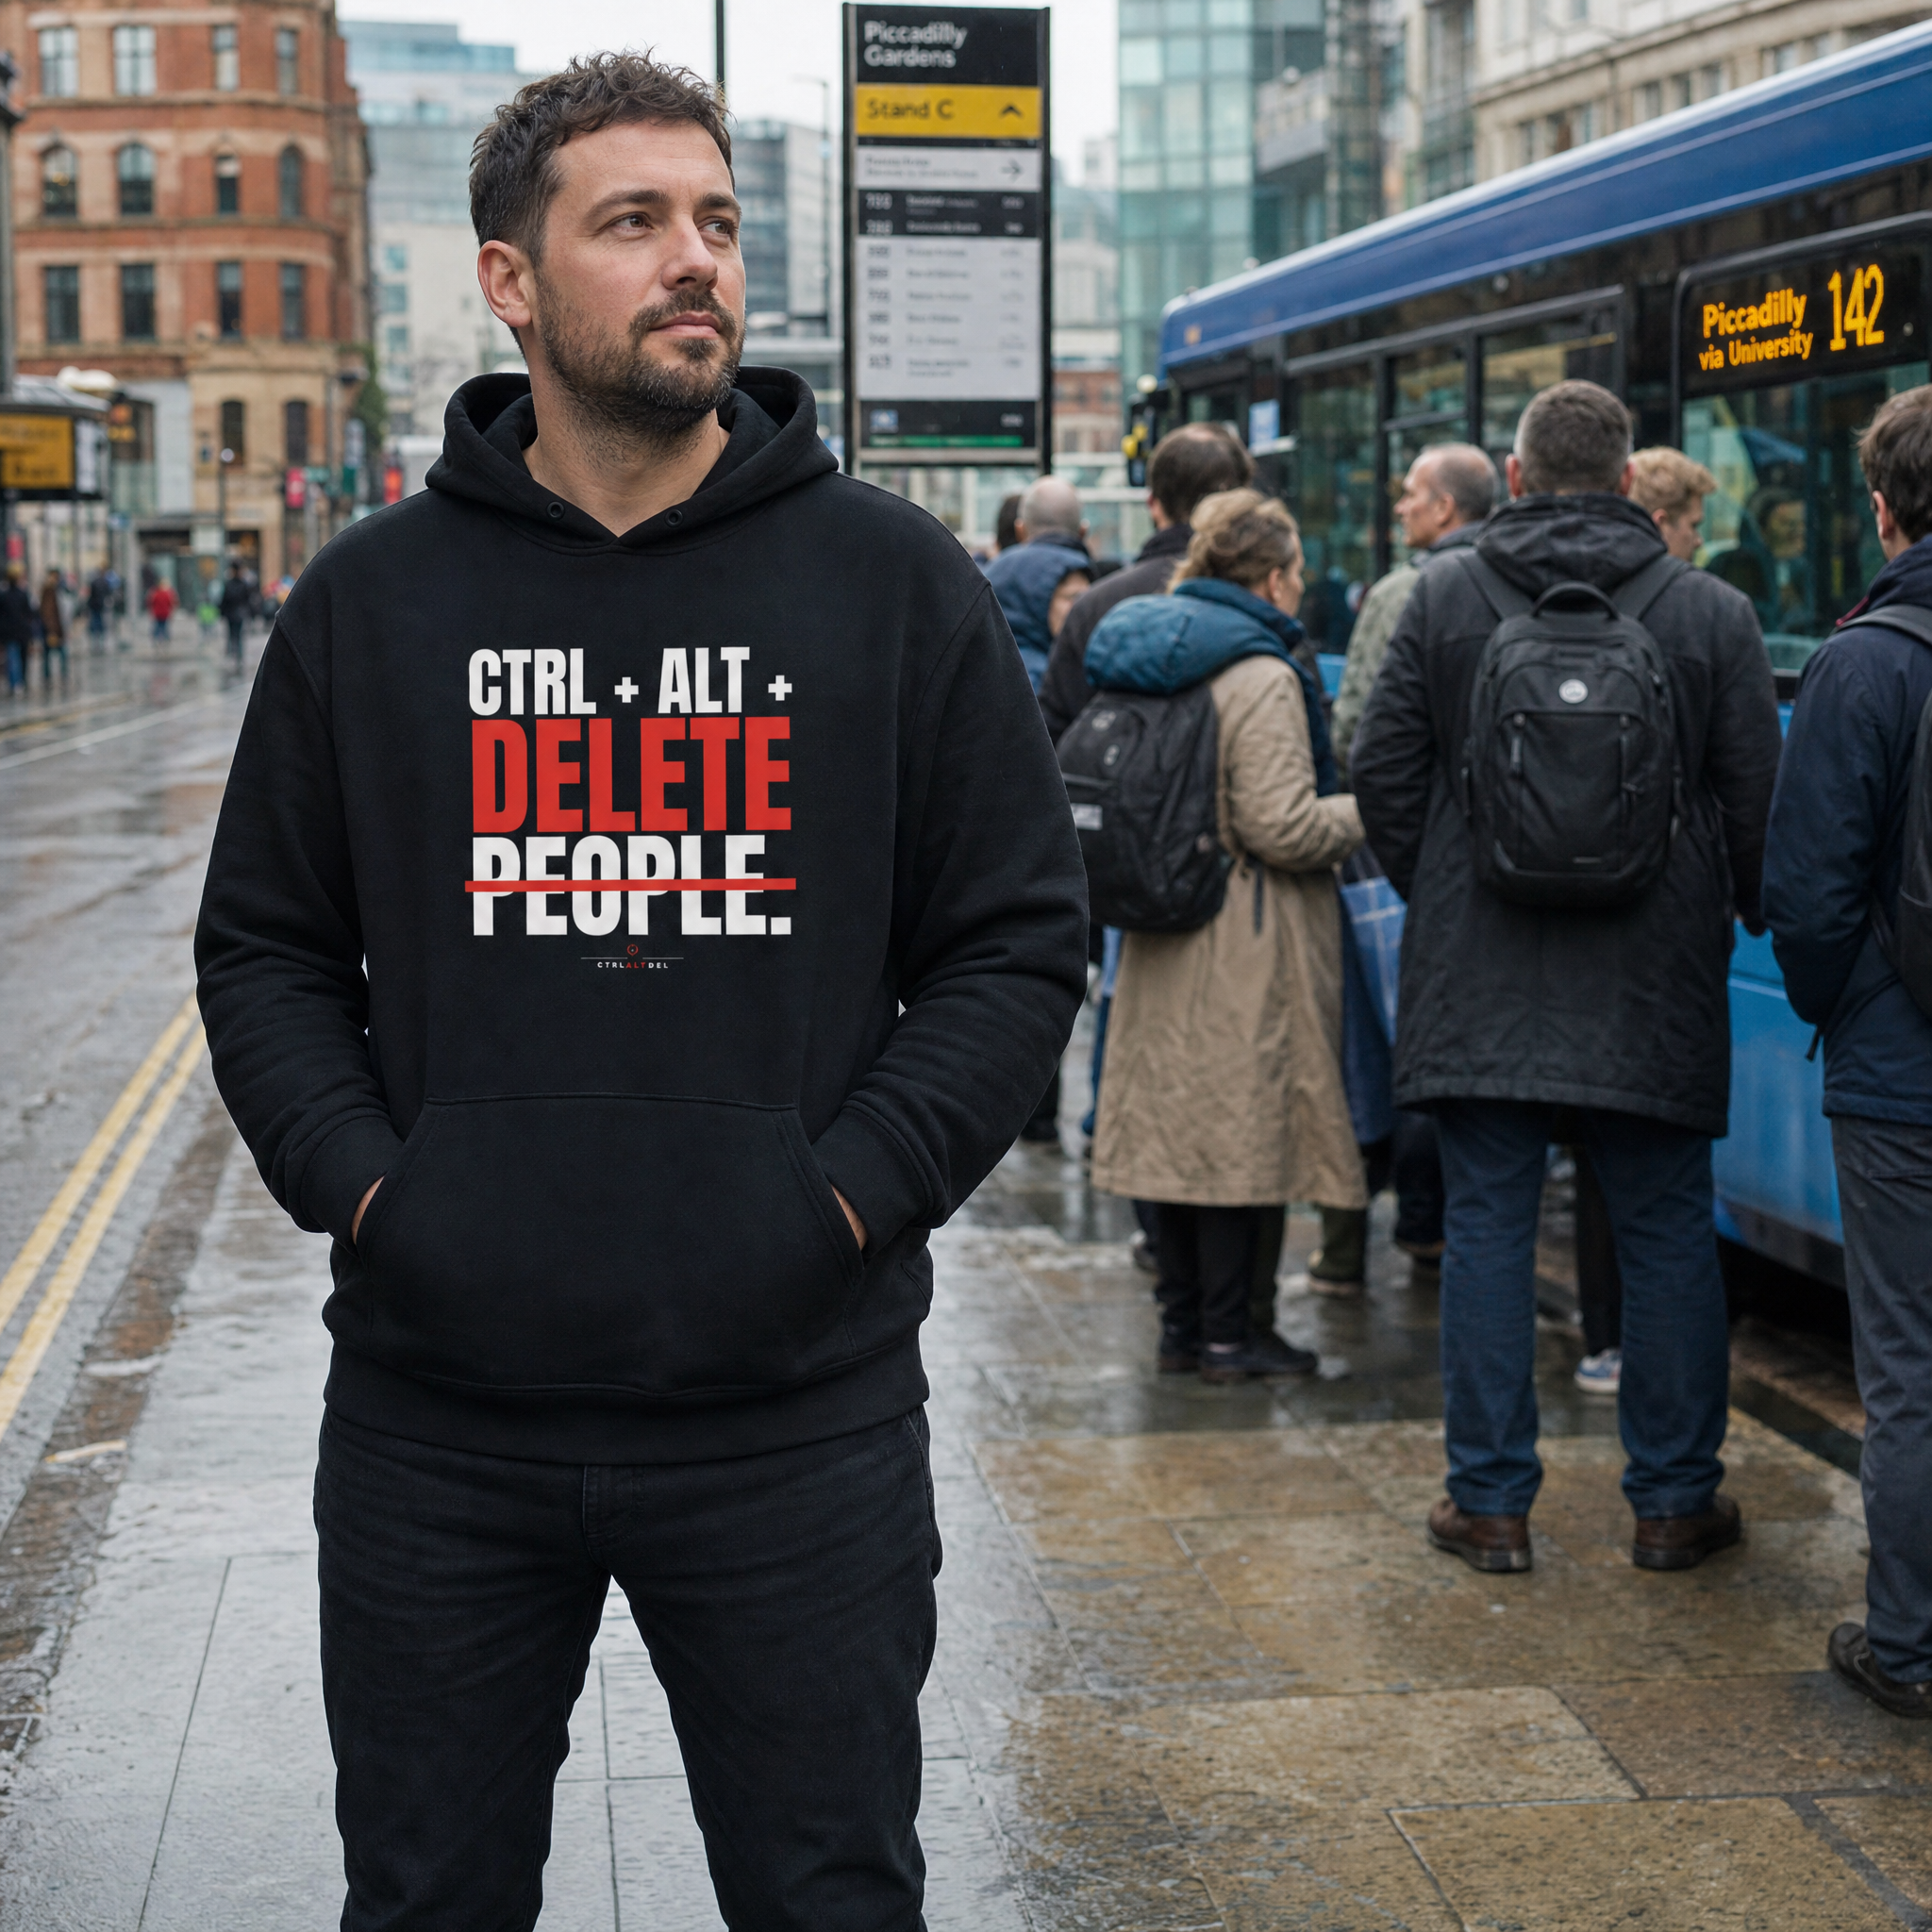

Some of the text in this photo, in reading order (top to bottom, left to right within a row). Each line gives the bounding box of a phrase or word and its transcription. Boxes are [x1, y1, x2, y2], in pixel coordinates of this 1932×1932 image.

[864, 20, 968, 49] Piccadilly
[864, 44, 957, 68] Gardens
[866, 98, 956, 120] Stand C
[1703, 288, 1807, 339] Piccadilly
[1828, 264, 1885, 351] 142
[1699, 328, 1814, 371] via University
[469, 646, 792, 716] CTRL + ALT +
[472, 716, 791, 833] DELETE
[473, 835, 791, 936] PEOPLE.
